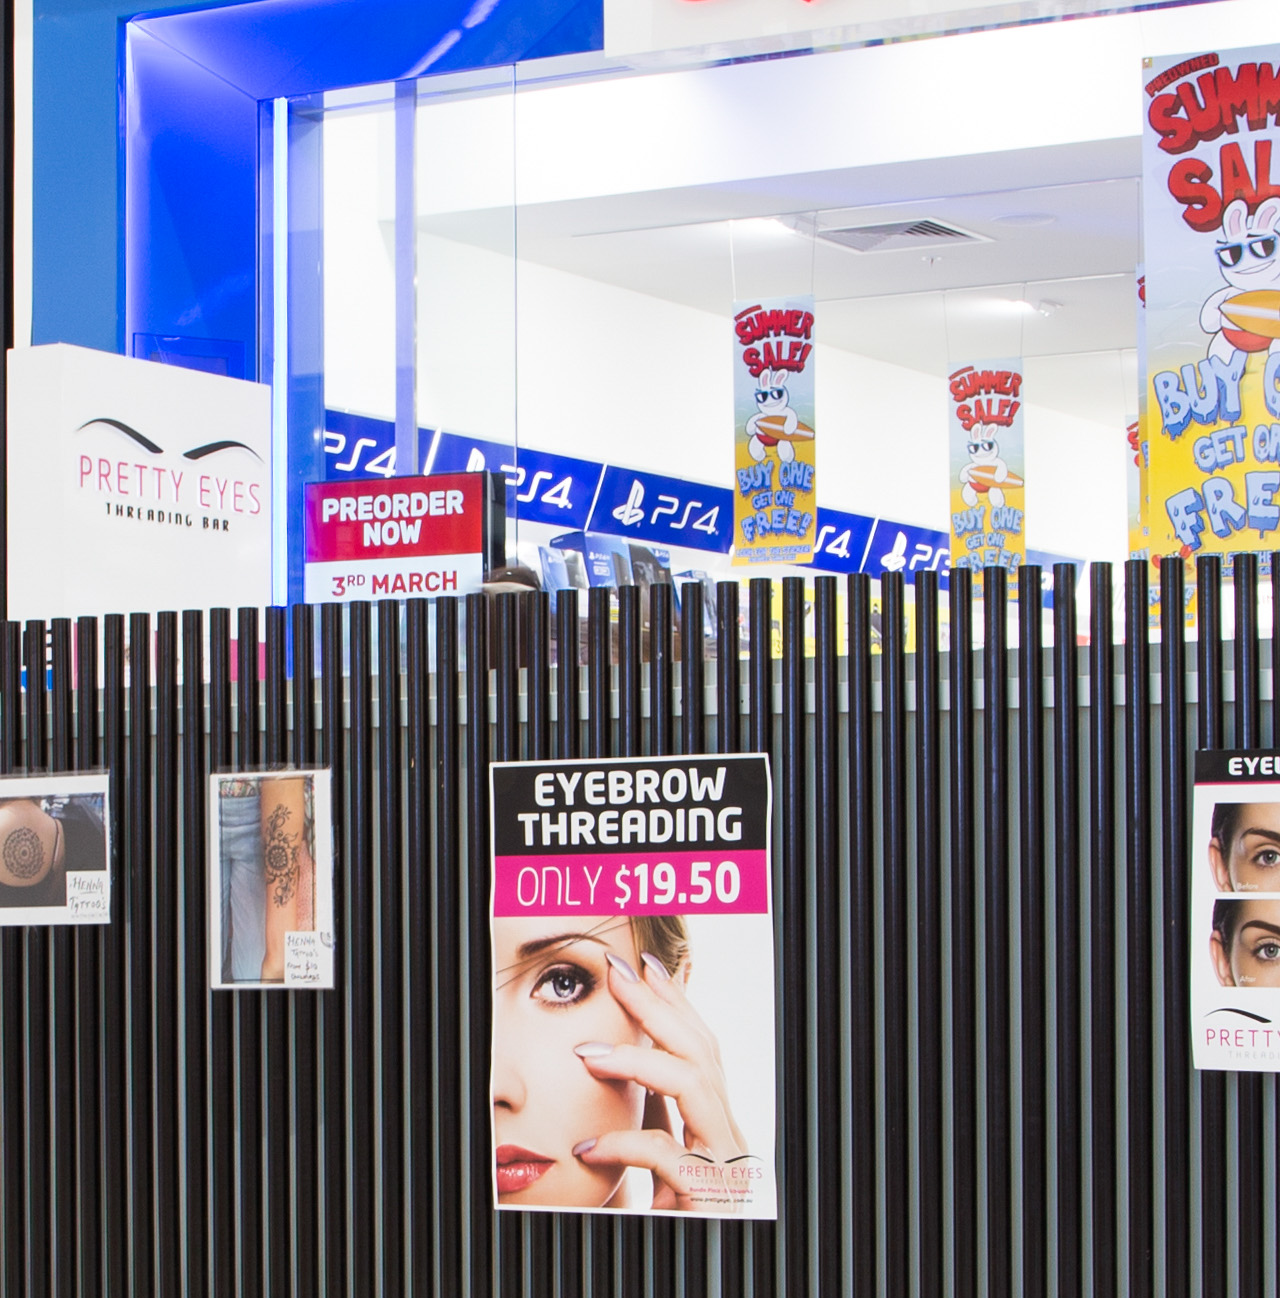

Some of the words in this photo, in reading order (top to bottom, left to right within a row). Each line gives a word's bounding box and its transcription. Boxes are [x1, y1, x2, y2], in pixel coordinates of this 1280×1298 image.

[735, 309, 815, 346] SUMMER
[743, 341, 813, 378] SALE!
[949, 370, 1022, 402] SUMMER
[1153, 349, 1247, 441] BUY
[956, 398, 1020, 431] SALE!
[324, 430, 396, 479] PS4
[1193, 424, 1247, 474] GET
[80, 455, 184, 500] PRETTY
[199, 475, 262, 516] EYES
[500, 464, 573, 509] PS4
[737, 461, 775, 496] BUY
[778, 461, 815, 493] ONE
[106, 502, 193, 527] THREADING
[203, 516, 231, 533] BAR
[322, 489, 464, 523] PREORDER
[651, 495, 719, 535] PS4
[752, 490, 774, 512] GET
[775, 490, 796, 510] ONE
[363, 519, 422, 547] NOW
[741, 509, 813, 543] FREE!
[952, 505, 986, 538] BUY
[990, 506, 1024, 535] ONE
[814, 525, 850, 558] S4
[966, 533, 986, 549] GET
[986, 533, 1006, 548] ONE
[332, 573, 366, 596] 3RD
[372, 570, 458, 595] MARCH
[534, 767, 727, 807] EYEBROW
[518, 807, 743, 846] THREADING
[517, 865, 603, 906] ONLY
[614, 861, 741, 910] $19.50
[1237, 882, 1258, 890] Before
[1240, 975, 1257, 983] After
[679, 1165, 725, 1178] PRETTY
[731, 1167, 763, 1179] EYES
